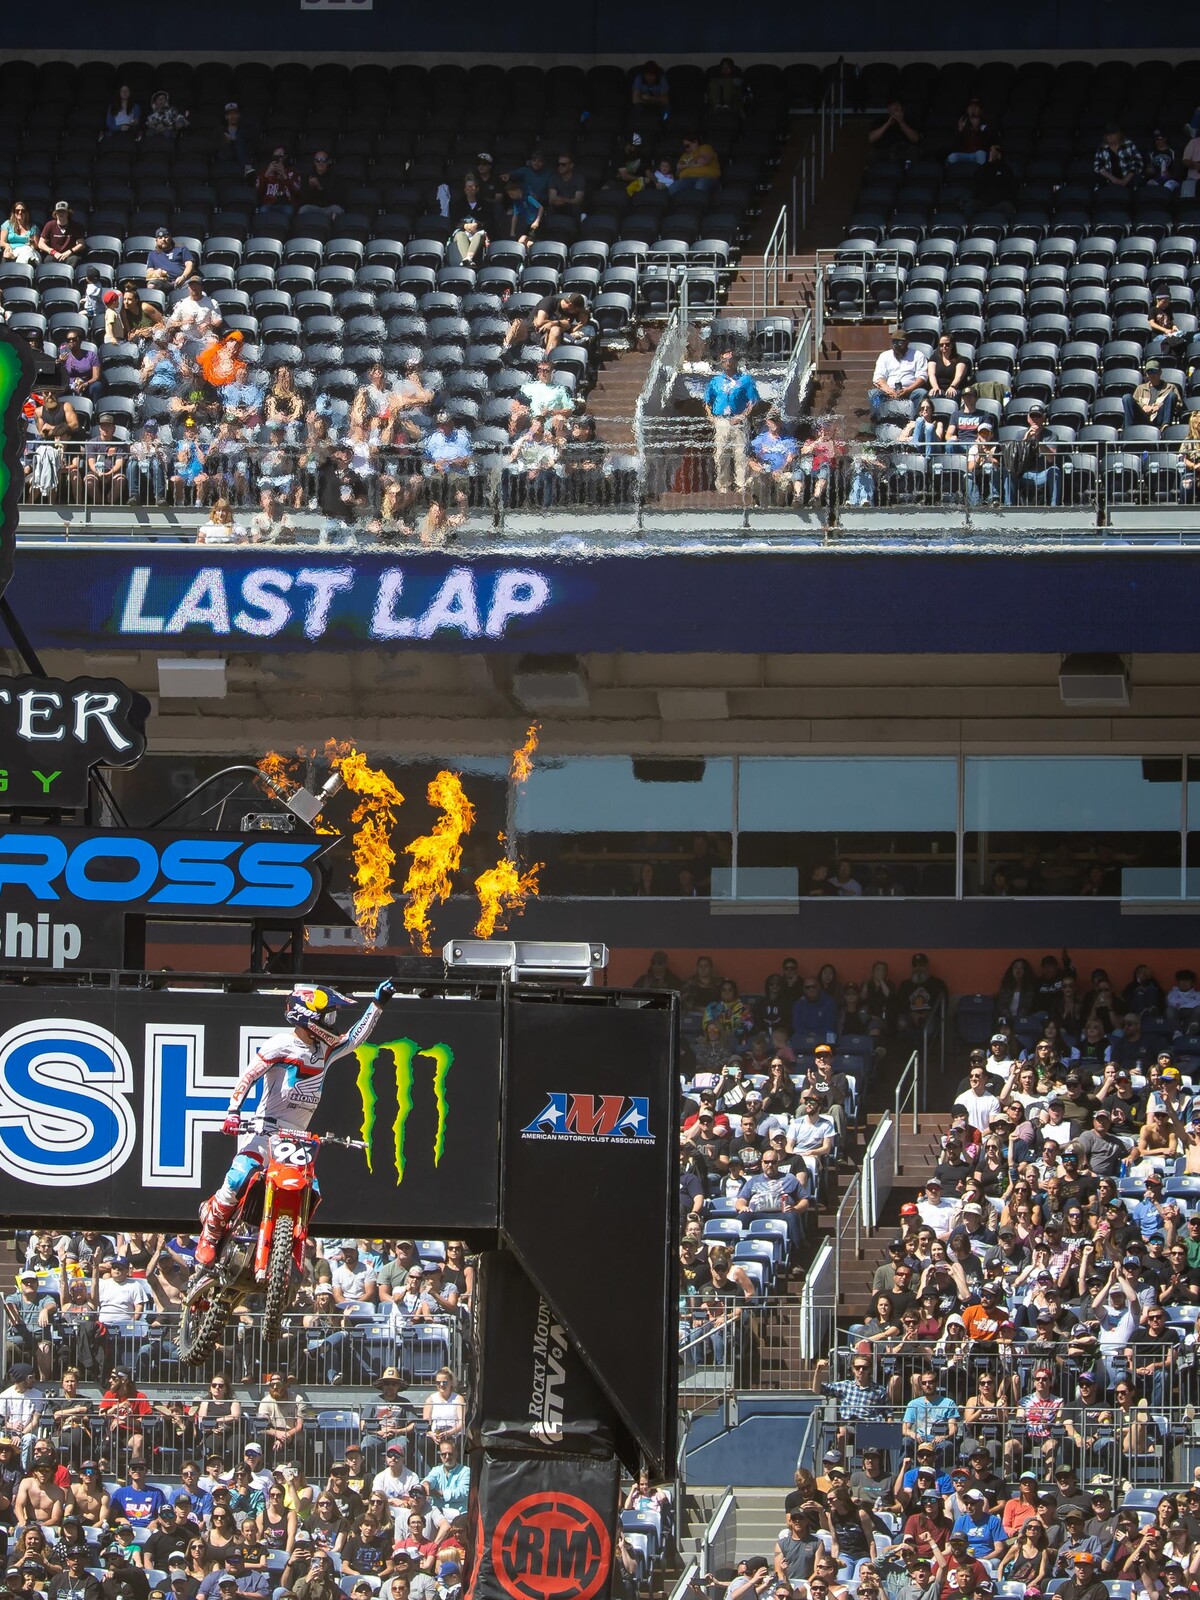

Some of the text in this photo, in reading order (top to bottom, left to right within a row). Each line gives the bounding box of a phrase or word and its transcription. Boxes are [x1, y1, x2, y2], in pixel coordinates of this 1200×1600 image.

[120, 566, 551, 641] LAST LAP
[292, 1003, 321, 1020] 100%
[352, 1011, 374, 1041] HONDA
[290, 1092, 320, 1105] HOND
[520, 1092, 657, 1138] AMA
[521, 1132, 656, 1145] AMERICAN MOTORCYCLIST ASSOCIATION
[273, 1142, 313, 1166] 96
[528, 1358, 546, 1419] ROCKY
[125, 1503, 152, 1512] SUN
[514, 1524, 590, 1581] RM
